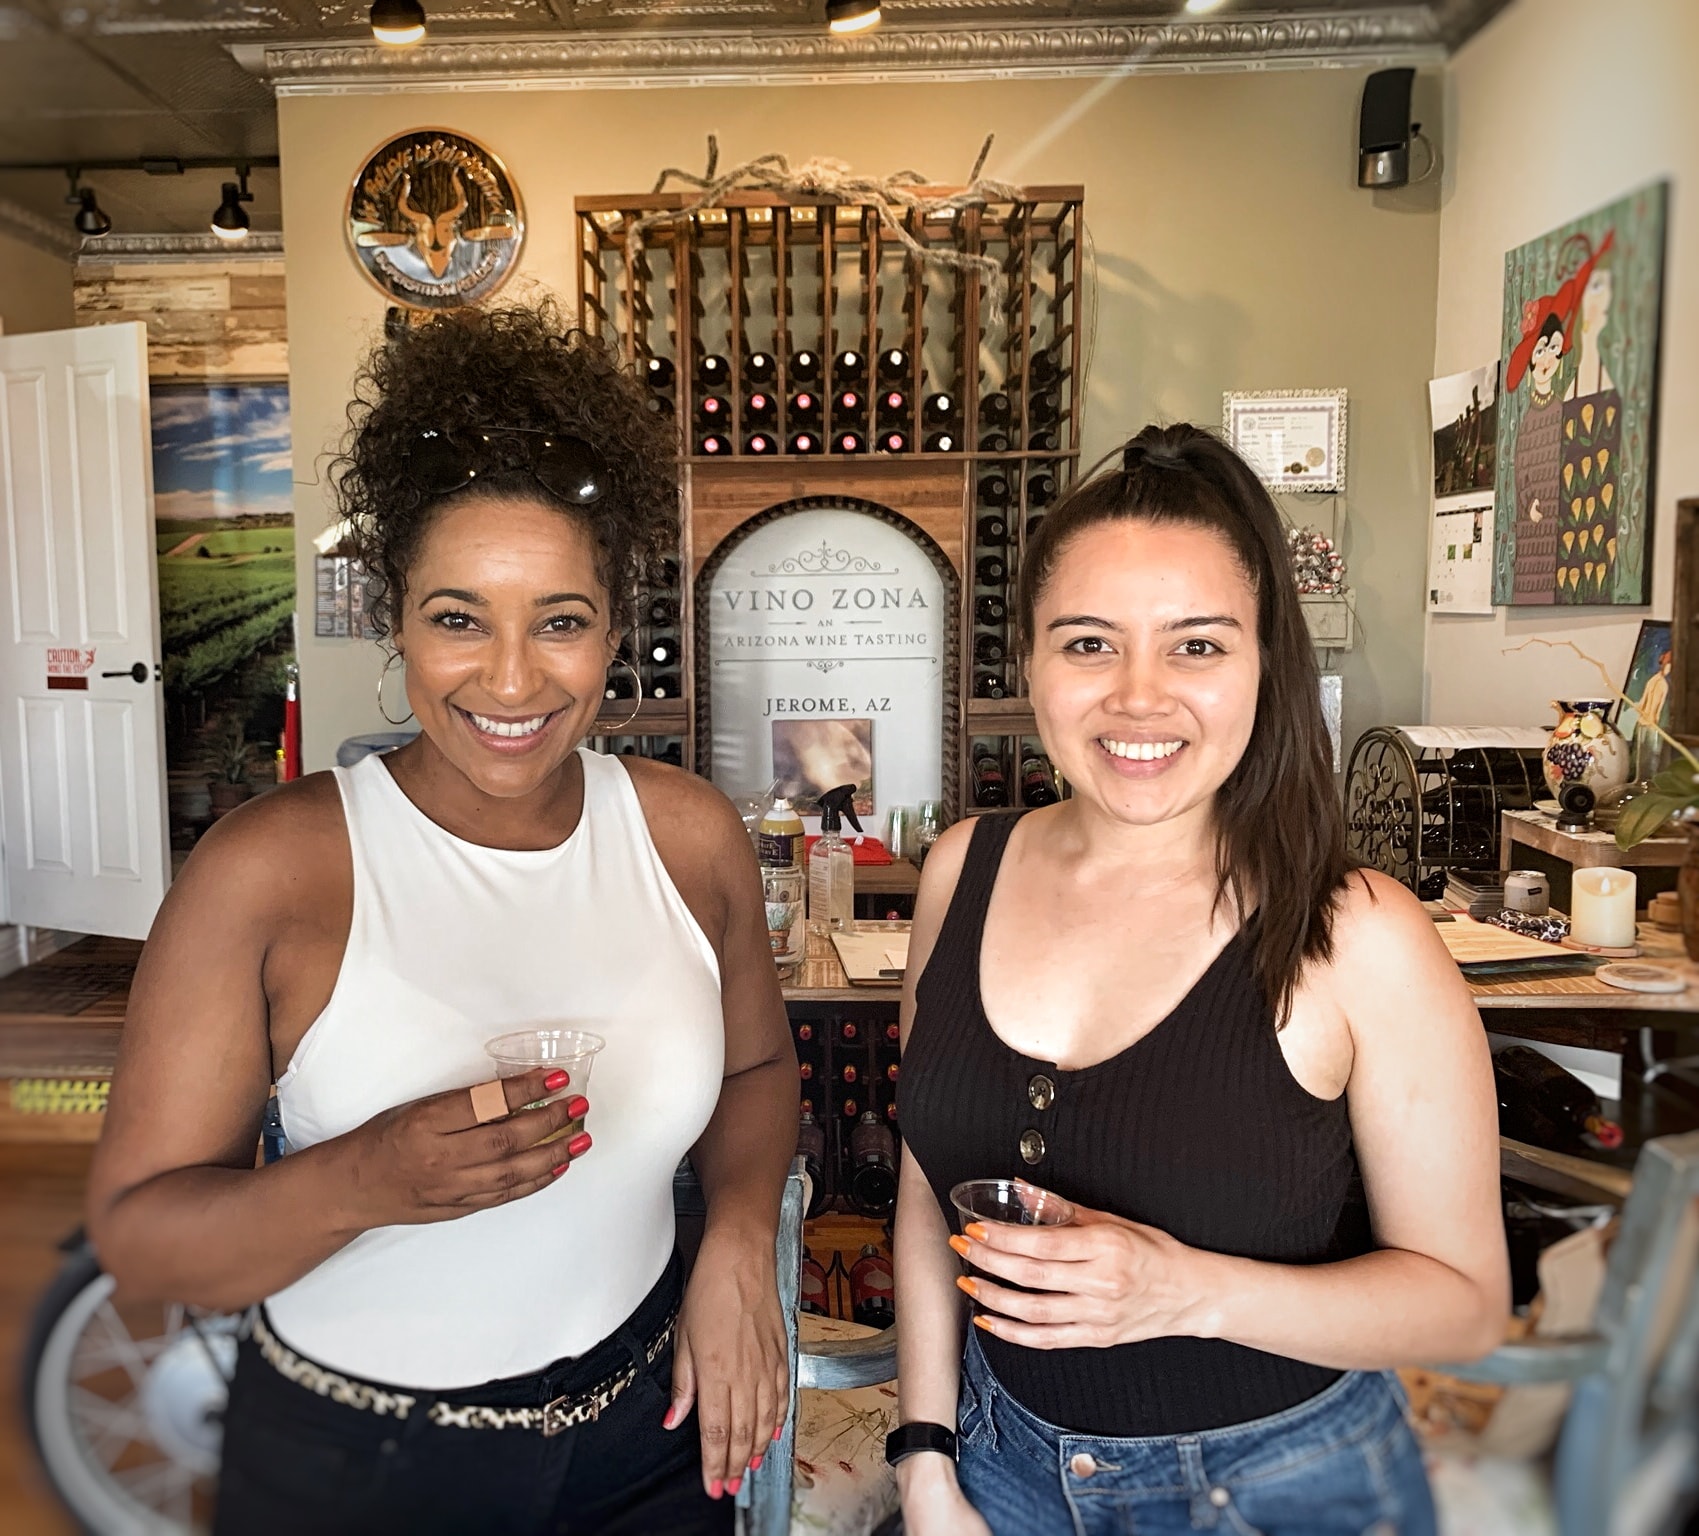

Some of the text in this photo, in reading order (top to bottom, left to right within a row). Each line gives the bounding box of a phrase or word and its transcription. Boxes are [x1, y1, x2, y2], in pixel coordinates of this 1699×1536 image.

[722, 587, 929, 611] VINO ZONA
[817, 619, 833, 627] AN
[724, 633, 928, 647] ARIZONA WINE TASTING
[762, 698, 892, 716] JEROME, AZ
